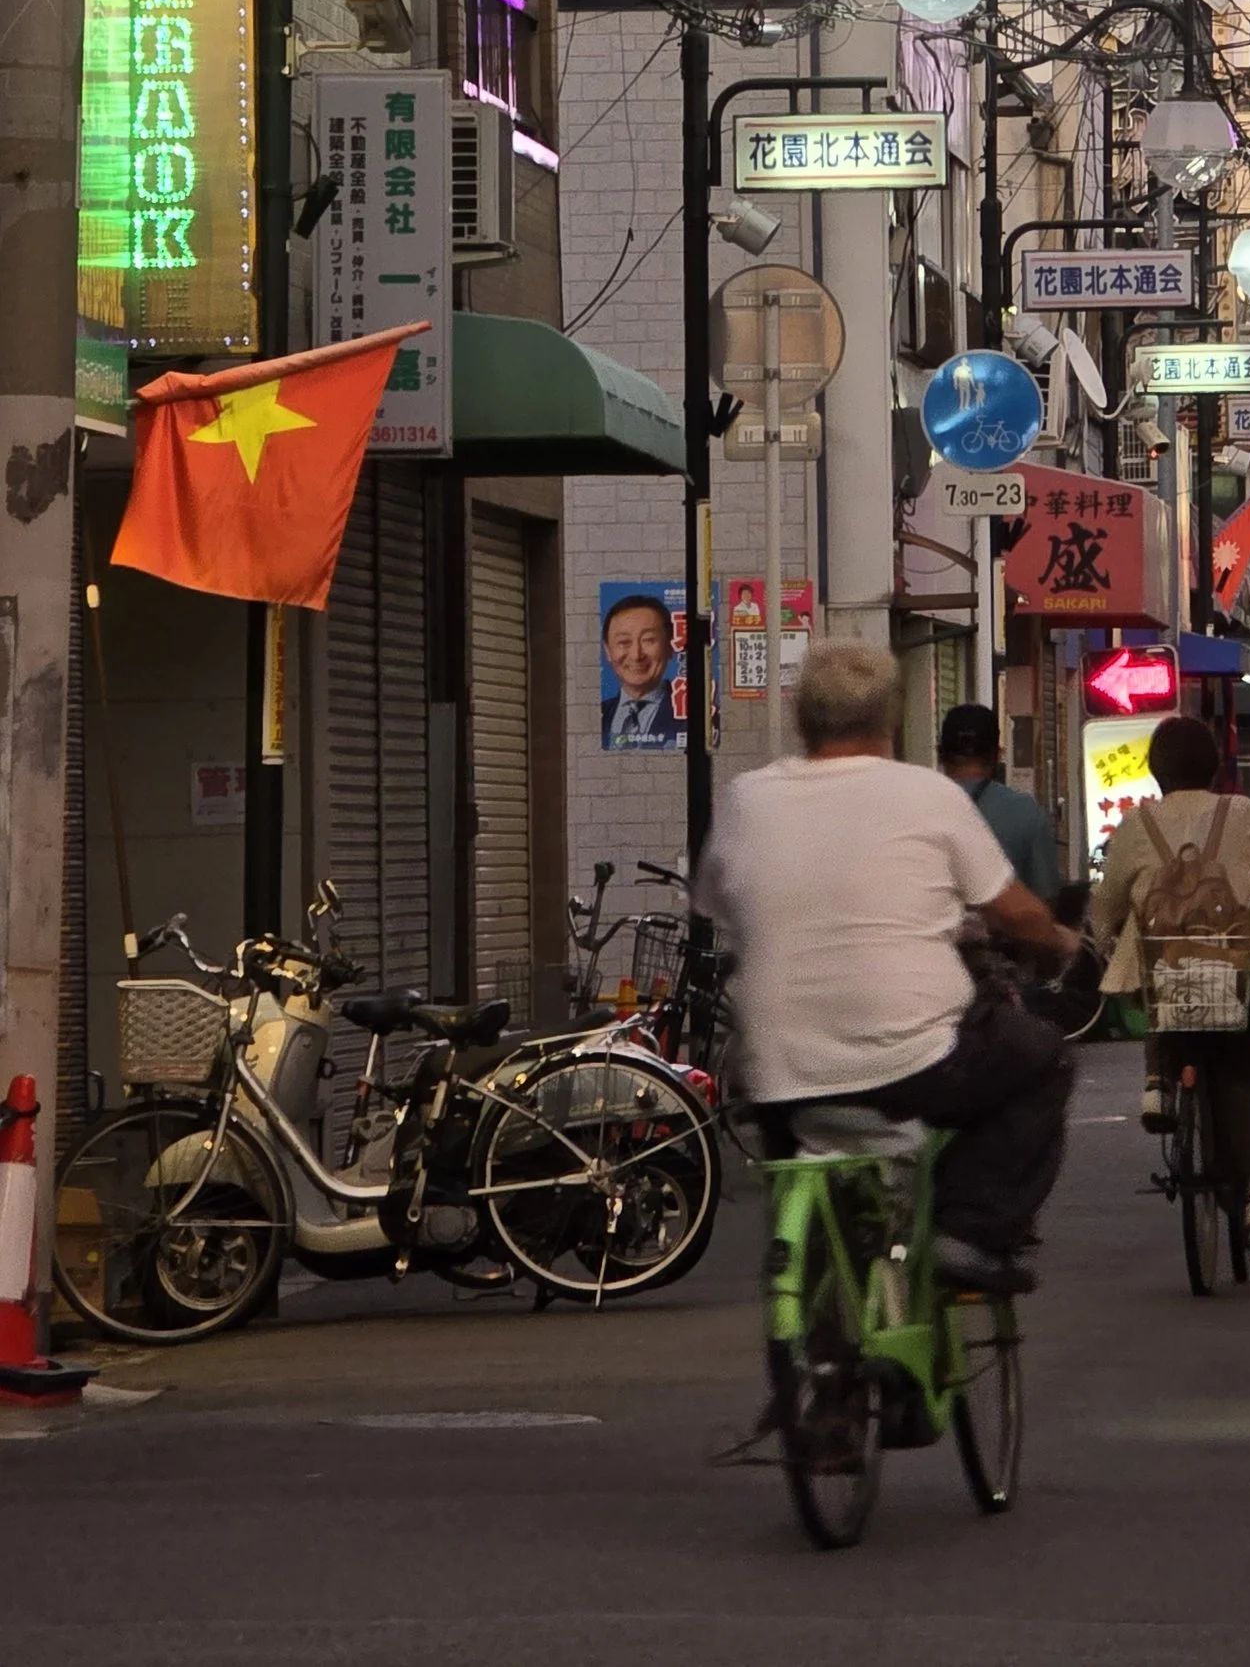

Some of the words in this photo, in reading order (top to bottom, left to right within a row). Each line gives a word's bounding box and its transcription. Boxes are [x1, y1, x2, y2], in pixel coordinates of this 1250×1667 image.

[384, 91, 417, 235] 有限会社
[749, 130, 934, 172] 花園北本通会
[1033, 263, 1183, 296] 花園北本通会
[368, 425, 438, 443] 36)1314
[1037, 521, 1112, 595] 盛
[1042, 597, 1109, 611] SAKARI
